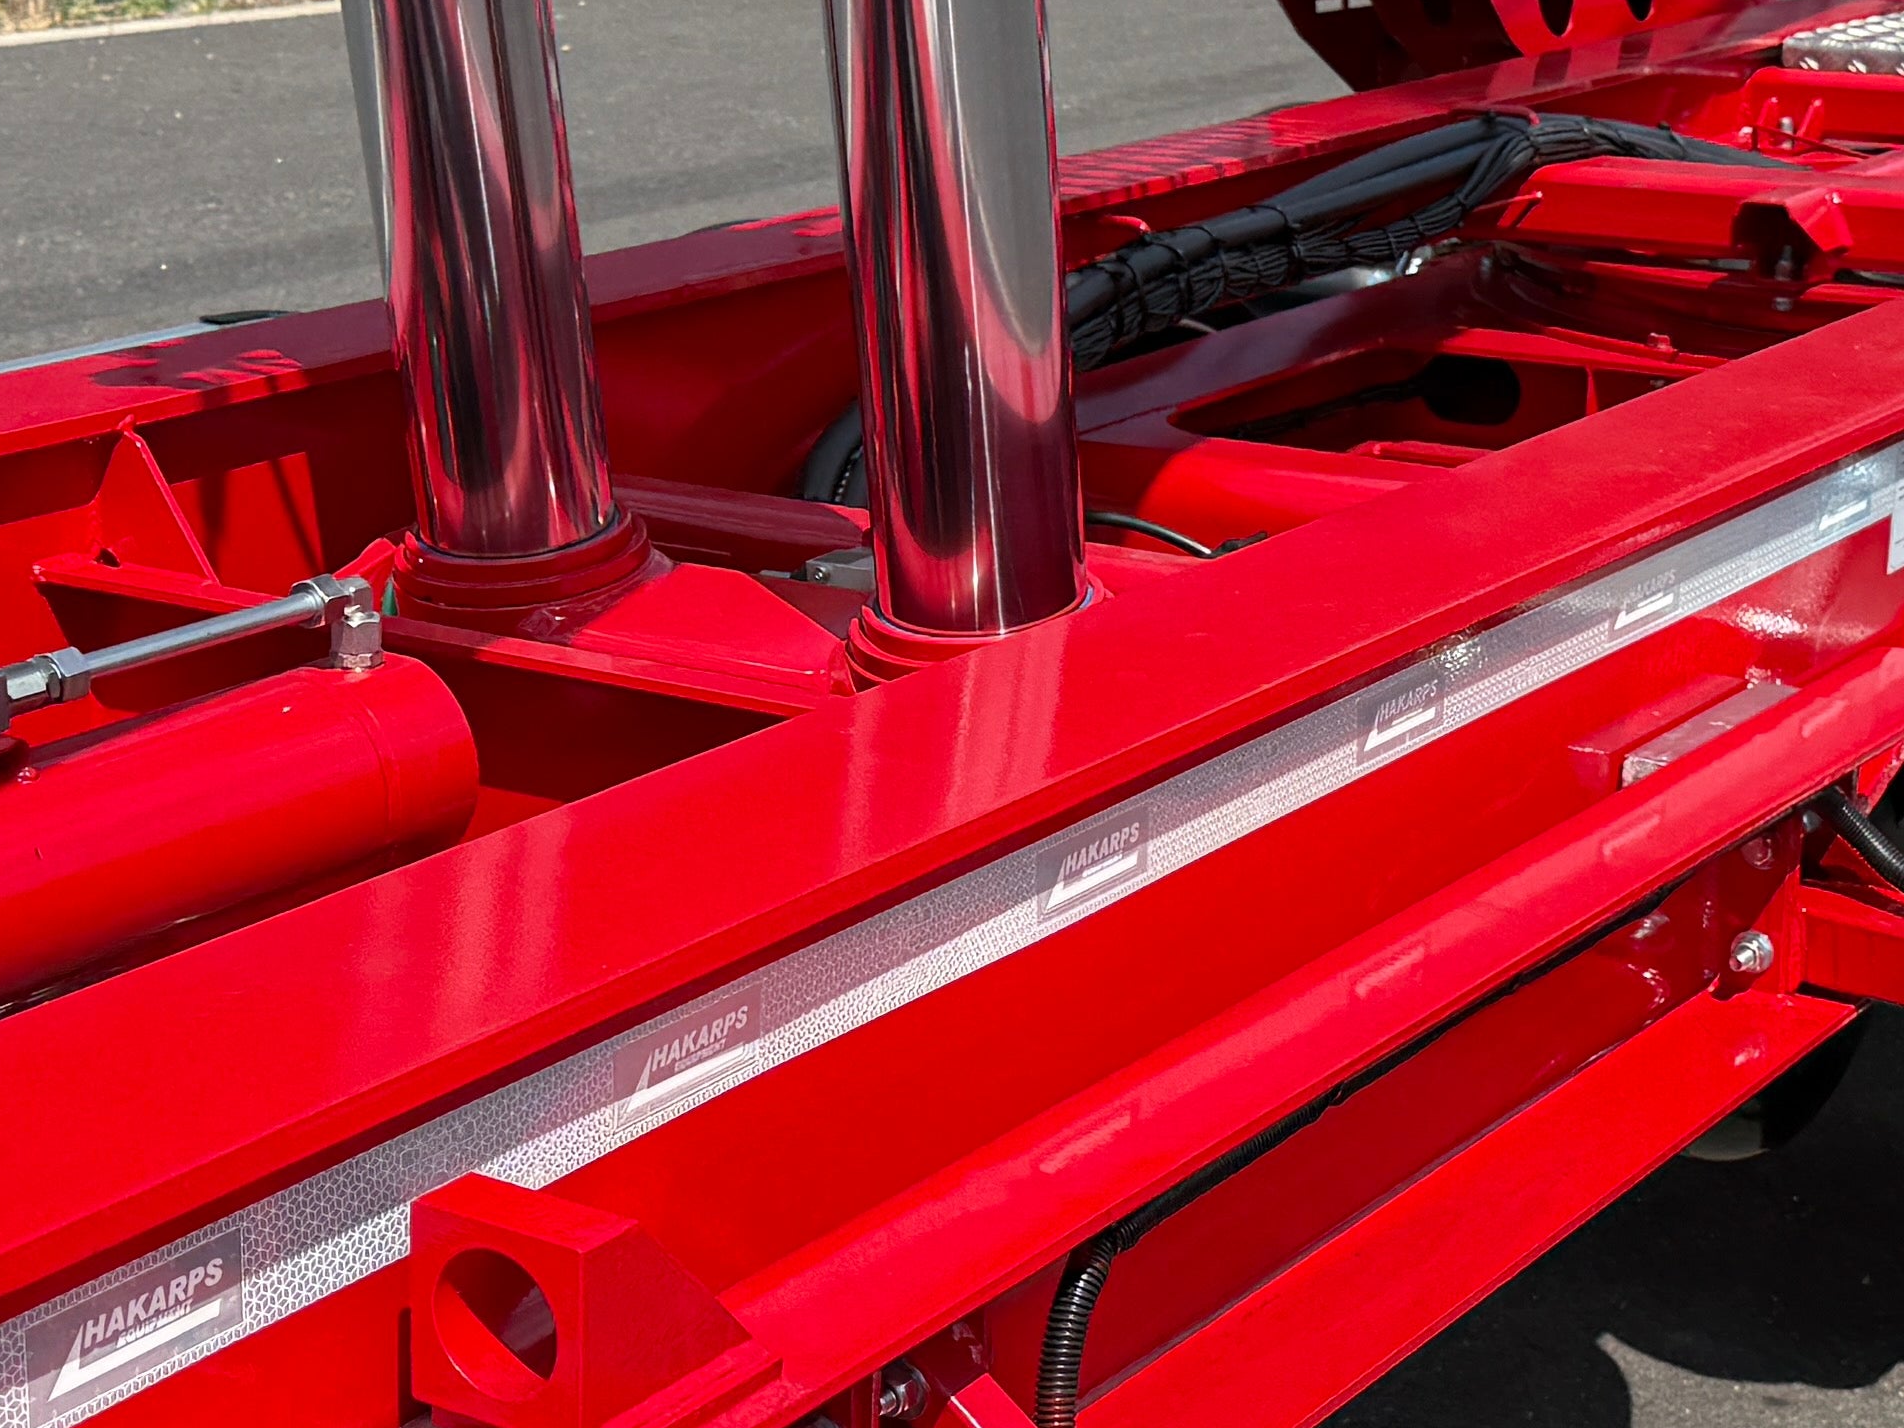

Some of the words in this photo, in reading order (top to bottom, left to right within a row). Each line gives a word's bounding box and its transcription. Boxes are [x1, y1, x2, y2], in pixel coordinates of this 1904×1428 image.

[1379, 679, 1439, 722] HAKARPS
[1065, 822, 1141, 876] HAKARPS
[652, 1005, 749, 1072] HAKARPS
[82, 1257, 224, 1349] HAKARPS
